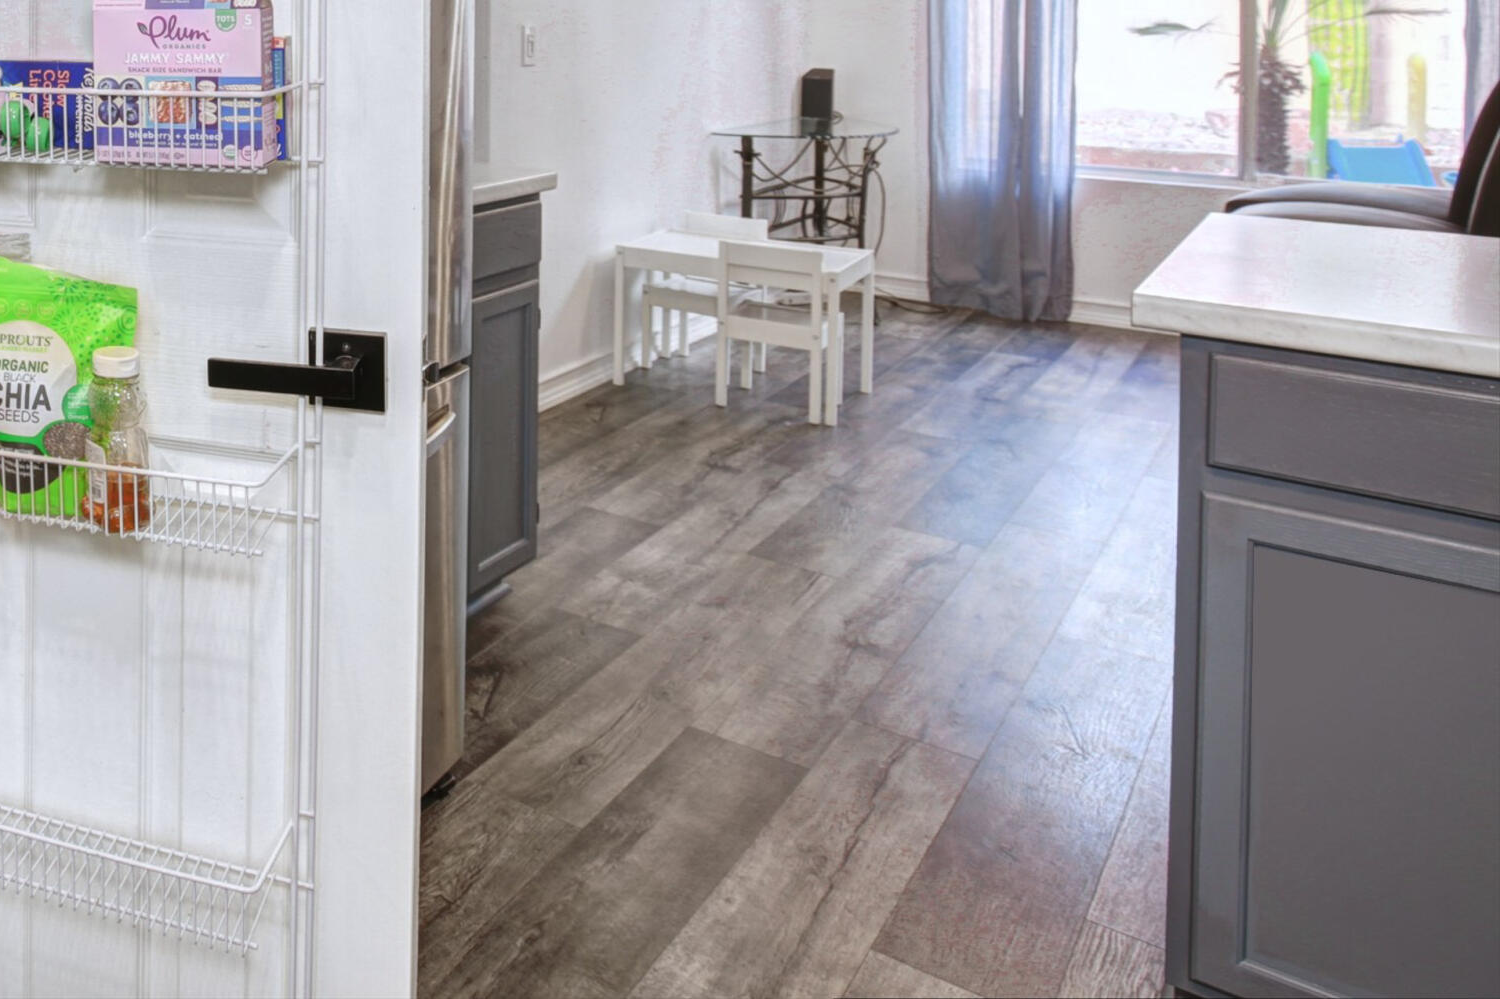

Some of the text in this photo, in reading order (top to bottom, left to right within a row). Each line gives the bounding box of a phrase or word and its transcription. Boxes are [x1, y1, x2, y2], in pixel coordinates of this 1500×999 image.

[216, 15, 236, 23] TOTS
[149, 15, 211, 49] Plum
[124, 53, 225, 65] JAMMY SAMMY
[3, 372, 36, 383] BLACK
